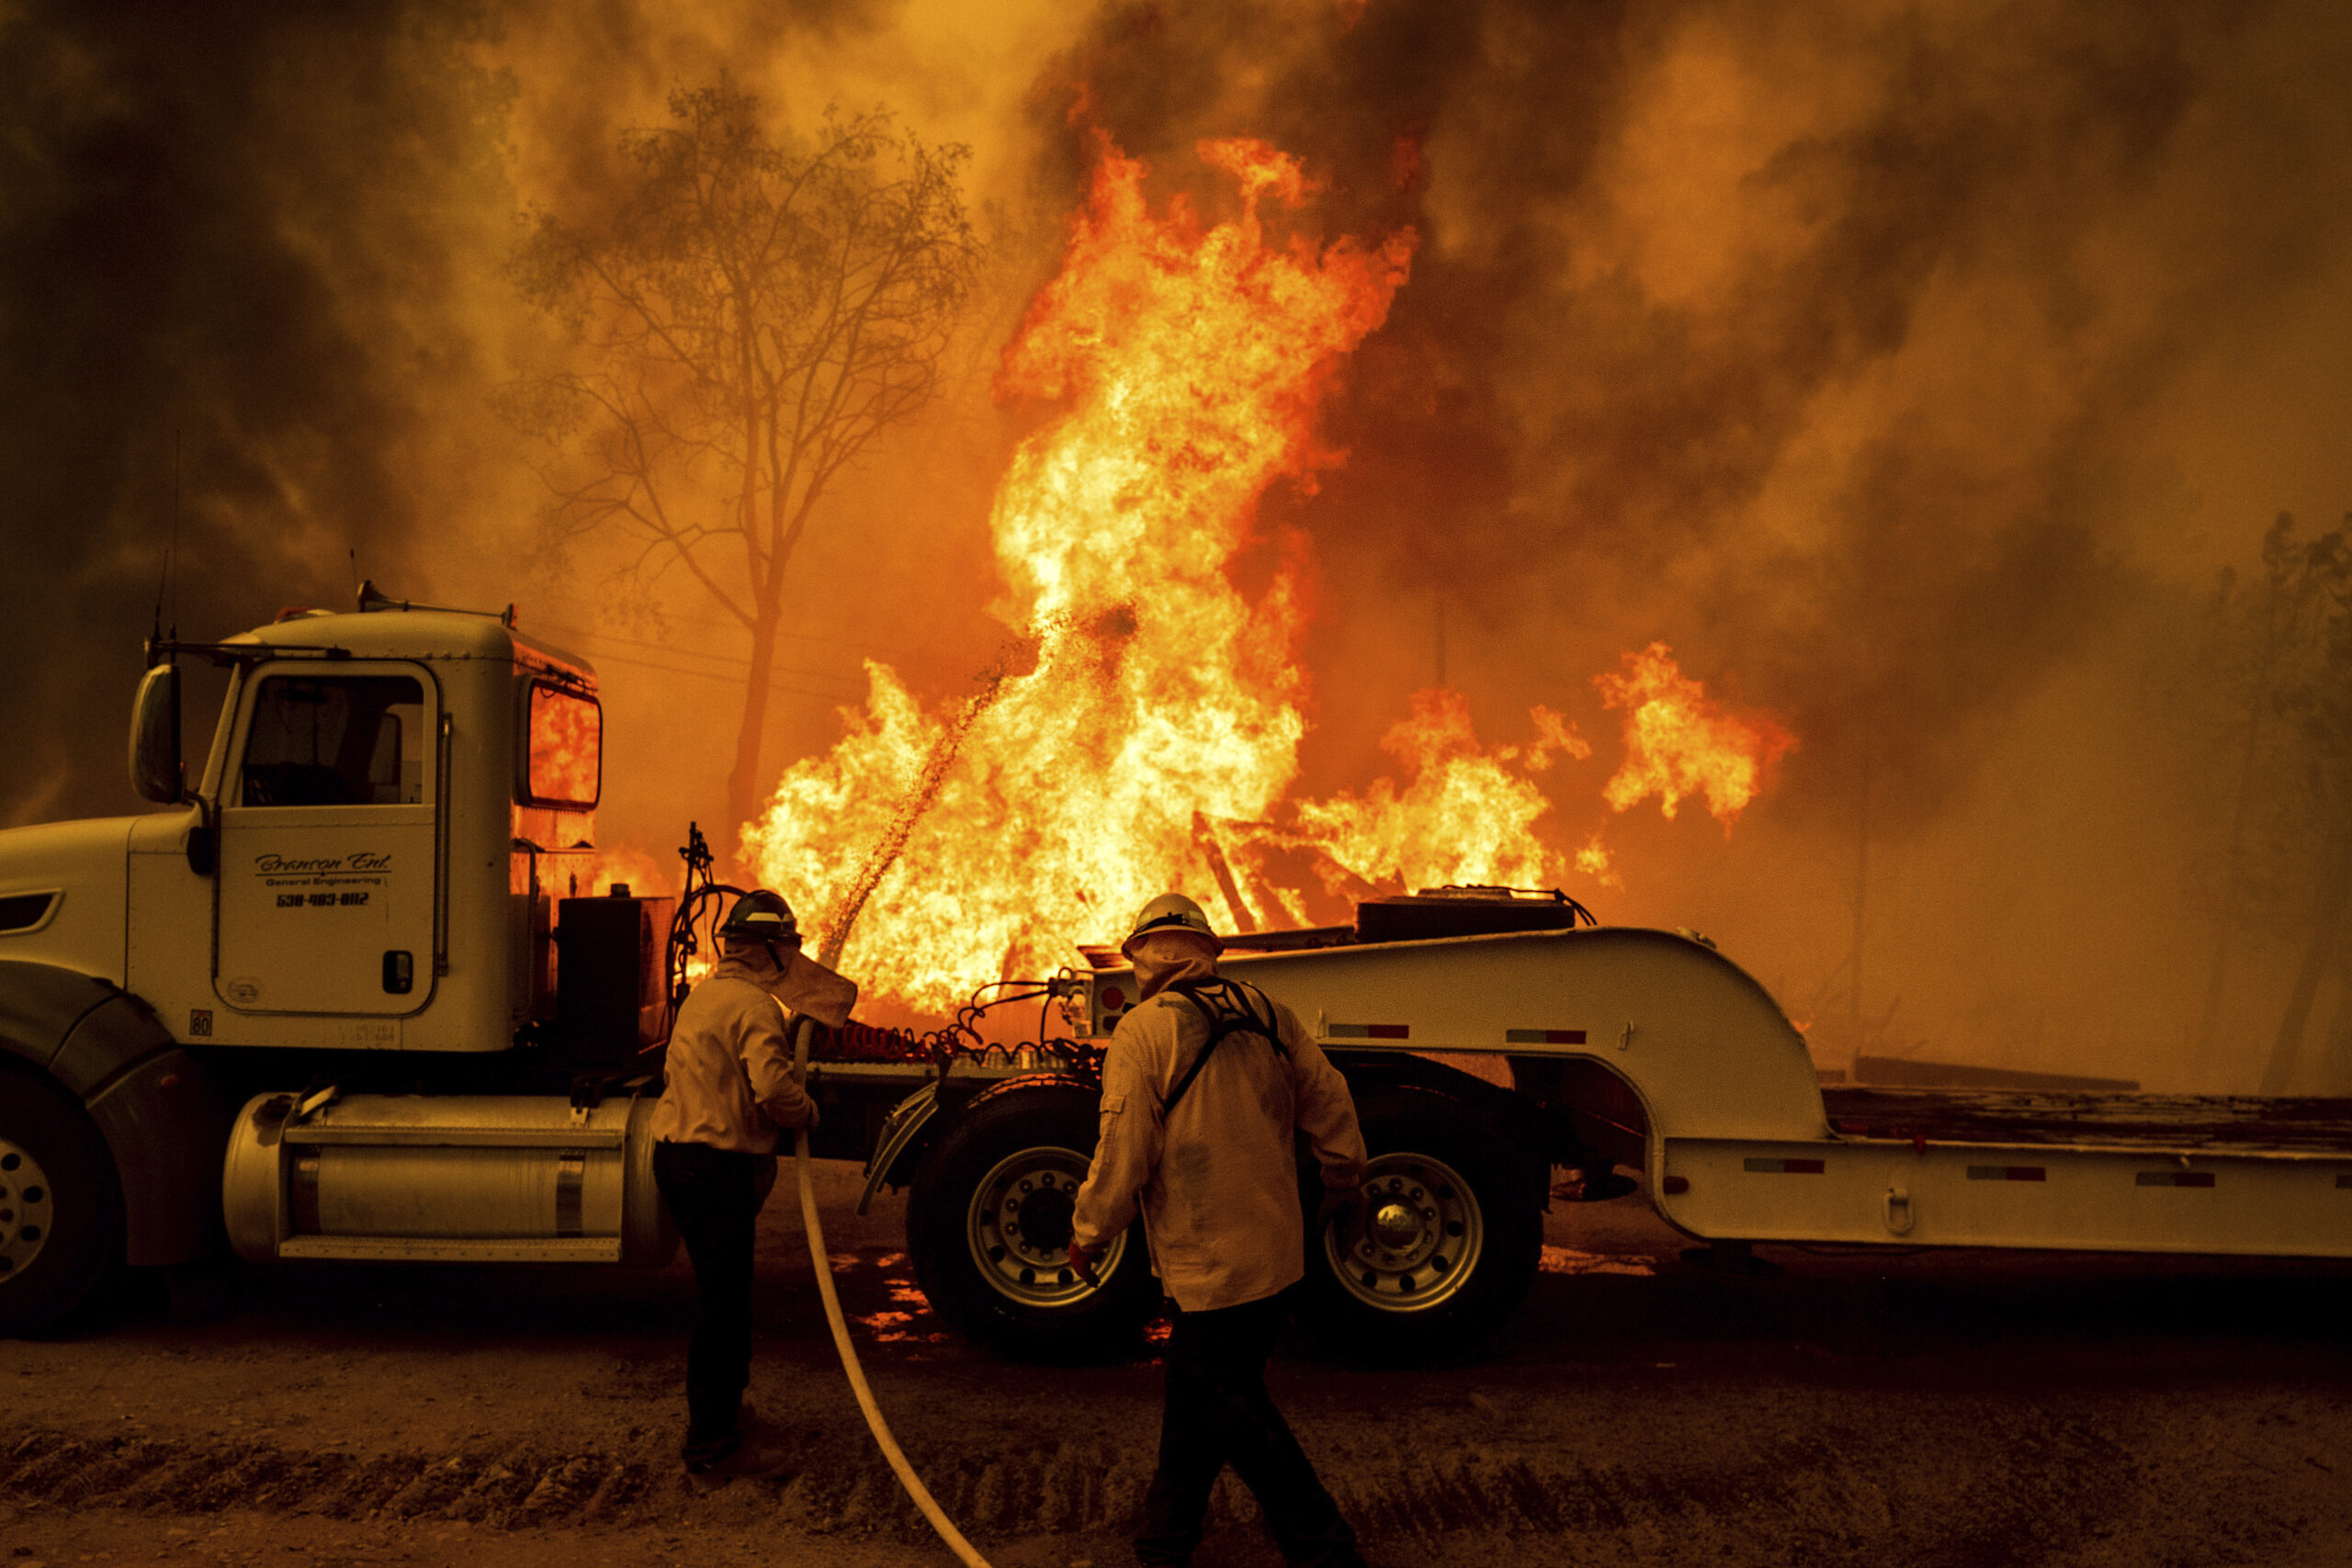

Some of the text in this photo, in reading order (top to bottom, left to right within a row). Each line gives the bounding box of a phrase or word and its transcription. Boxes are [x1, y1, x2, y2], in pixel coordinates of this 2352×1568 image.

[254, 853, 342, 872] Branson
[266, 877, 381, 886] General Engineering
[192, 1017, 209, 1033] 80
